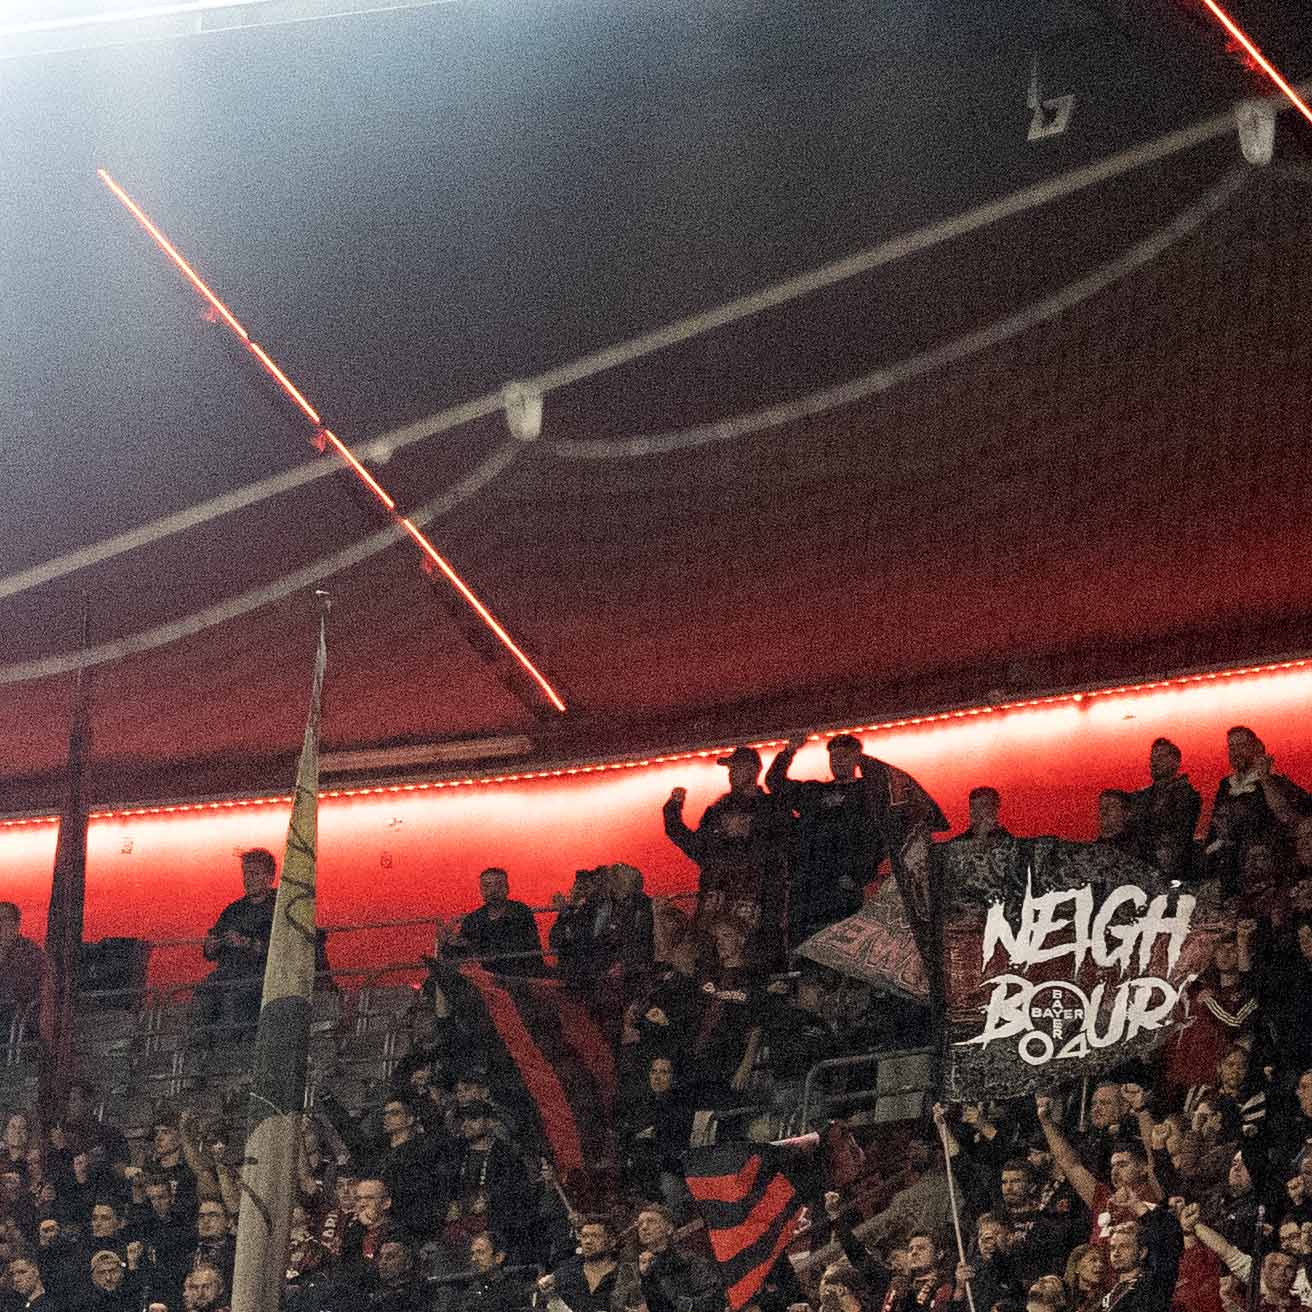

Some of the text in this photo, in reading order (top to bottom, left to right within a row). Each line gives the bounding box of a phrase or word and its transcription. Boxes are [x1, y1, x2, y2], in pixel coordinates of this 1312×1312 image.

[981, 865, 1197, 976] NEIGH
[1031, 1006, 1084, 1020] BAYER
[1019, 1033, 1089, 1066] 04
